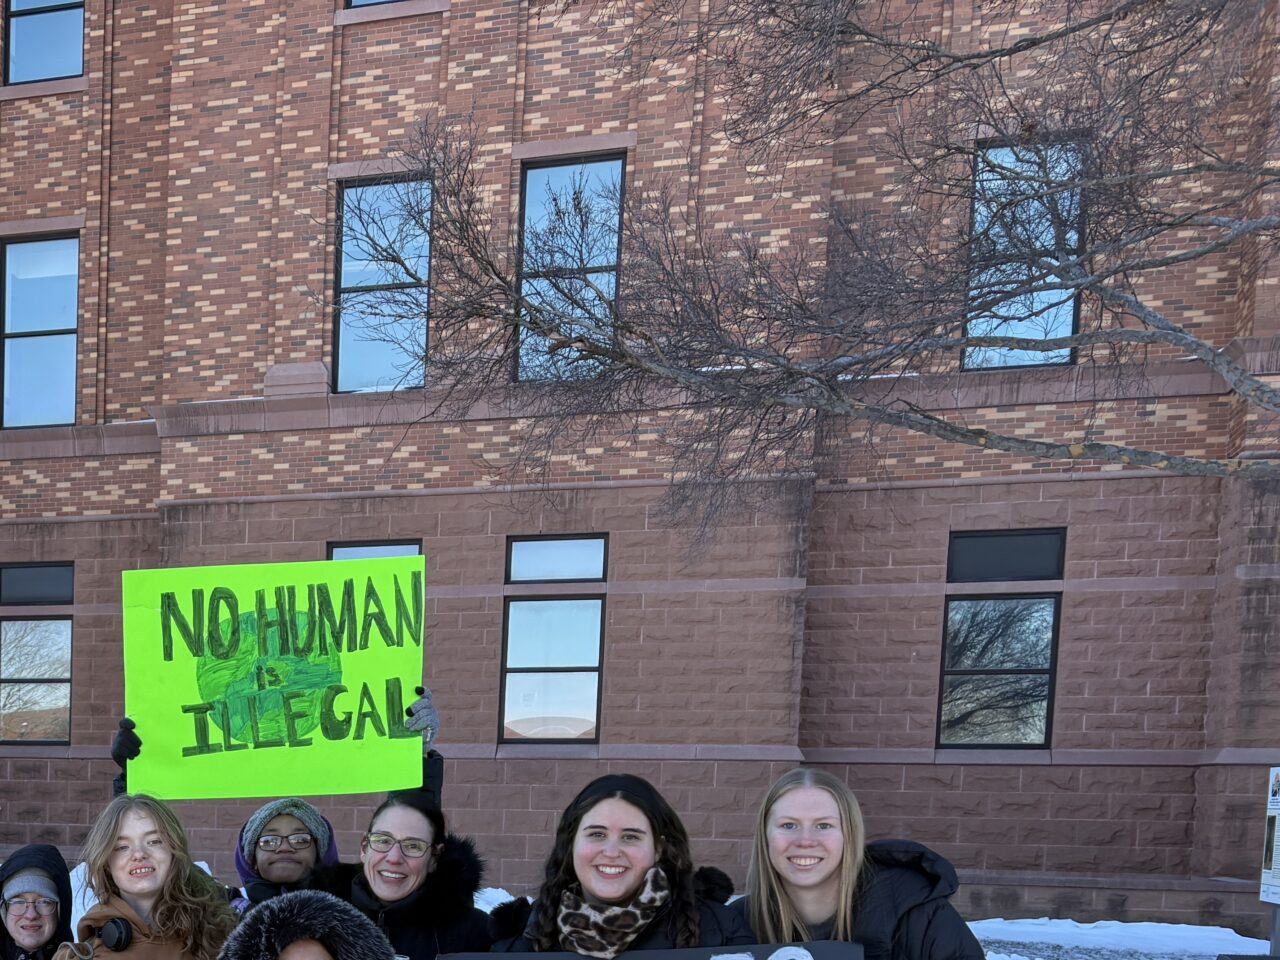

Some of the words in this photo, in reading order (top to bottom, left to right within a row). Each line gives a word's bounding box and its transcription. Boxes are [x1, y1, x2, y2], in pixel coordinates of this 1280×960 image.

[160, 587, 240, 661] NO
[255, 571, 421, 657] HUMAN
[181, 677, 422, 757] ILLEGAL
